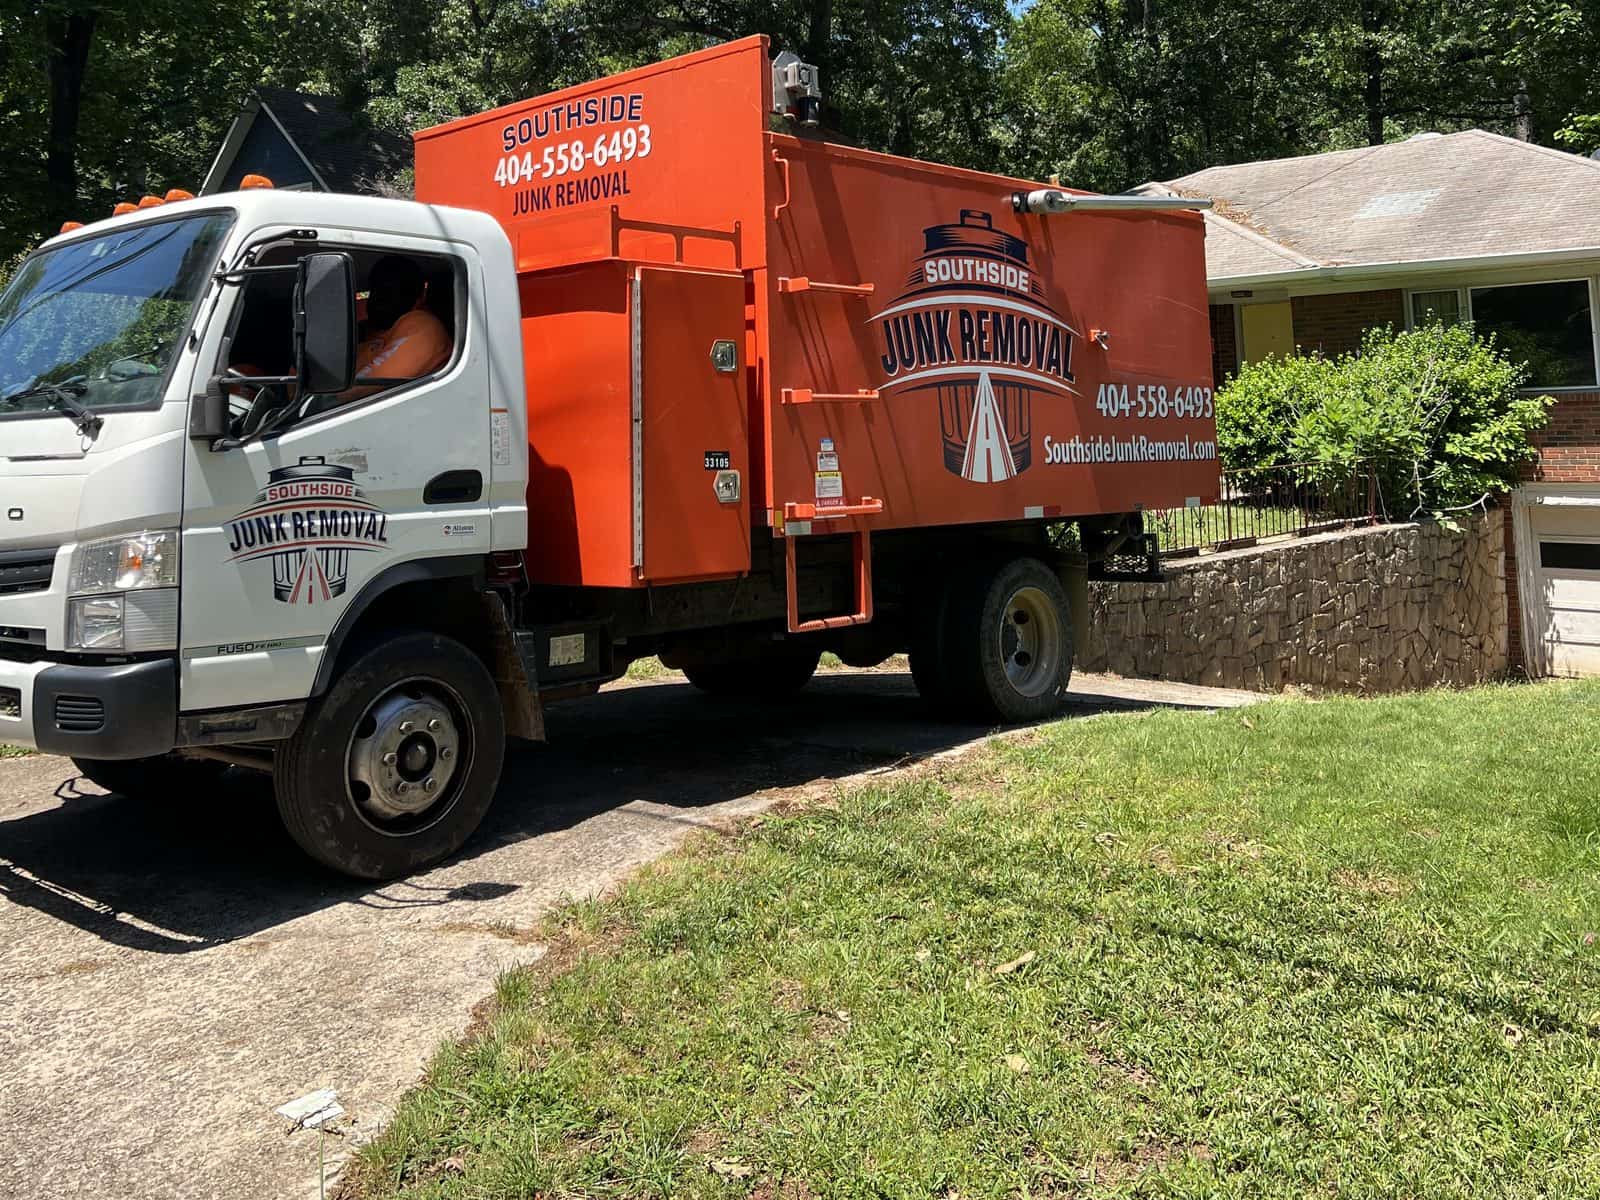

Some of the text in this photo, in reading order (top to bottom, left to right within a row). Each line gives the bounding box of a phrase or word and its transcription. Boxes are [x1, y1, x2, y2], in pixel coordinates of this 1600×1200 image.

[502, 94, 643, 151] SOUTHSIDE
[494, 124, 652, 187] 404-558-6493
[513, 170, 631, 216] JUNK REMOVAL
[925, 259, 1029, 292] SOUTHSIDE
[881, 309, 1075, 384] JUNK REMOVAL
[1096, 383, 1214, 419] 404-558-6493
[704, 457, 729, 468] 33105
[1044, 433, 1216, 465] SouthsideJunkRemoval.com
[268, 483, 354, 500] SOUTHSIDE
[229, 510, 388, 552] JUNK REMOVAL
[217, 643, 255, 654] FUSO
